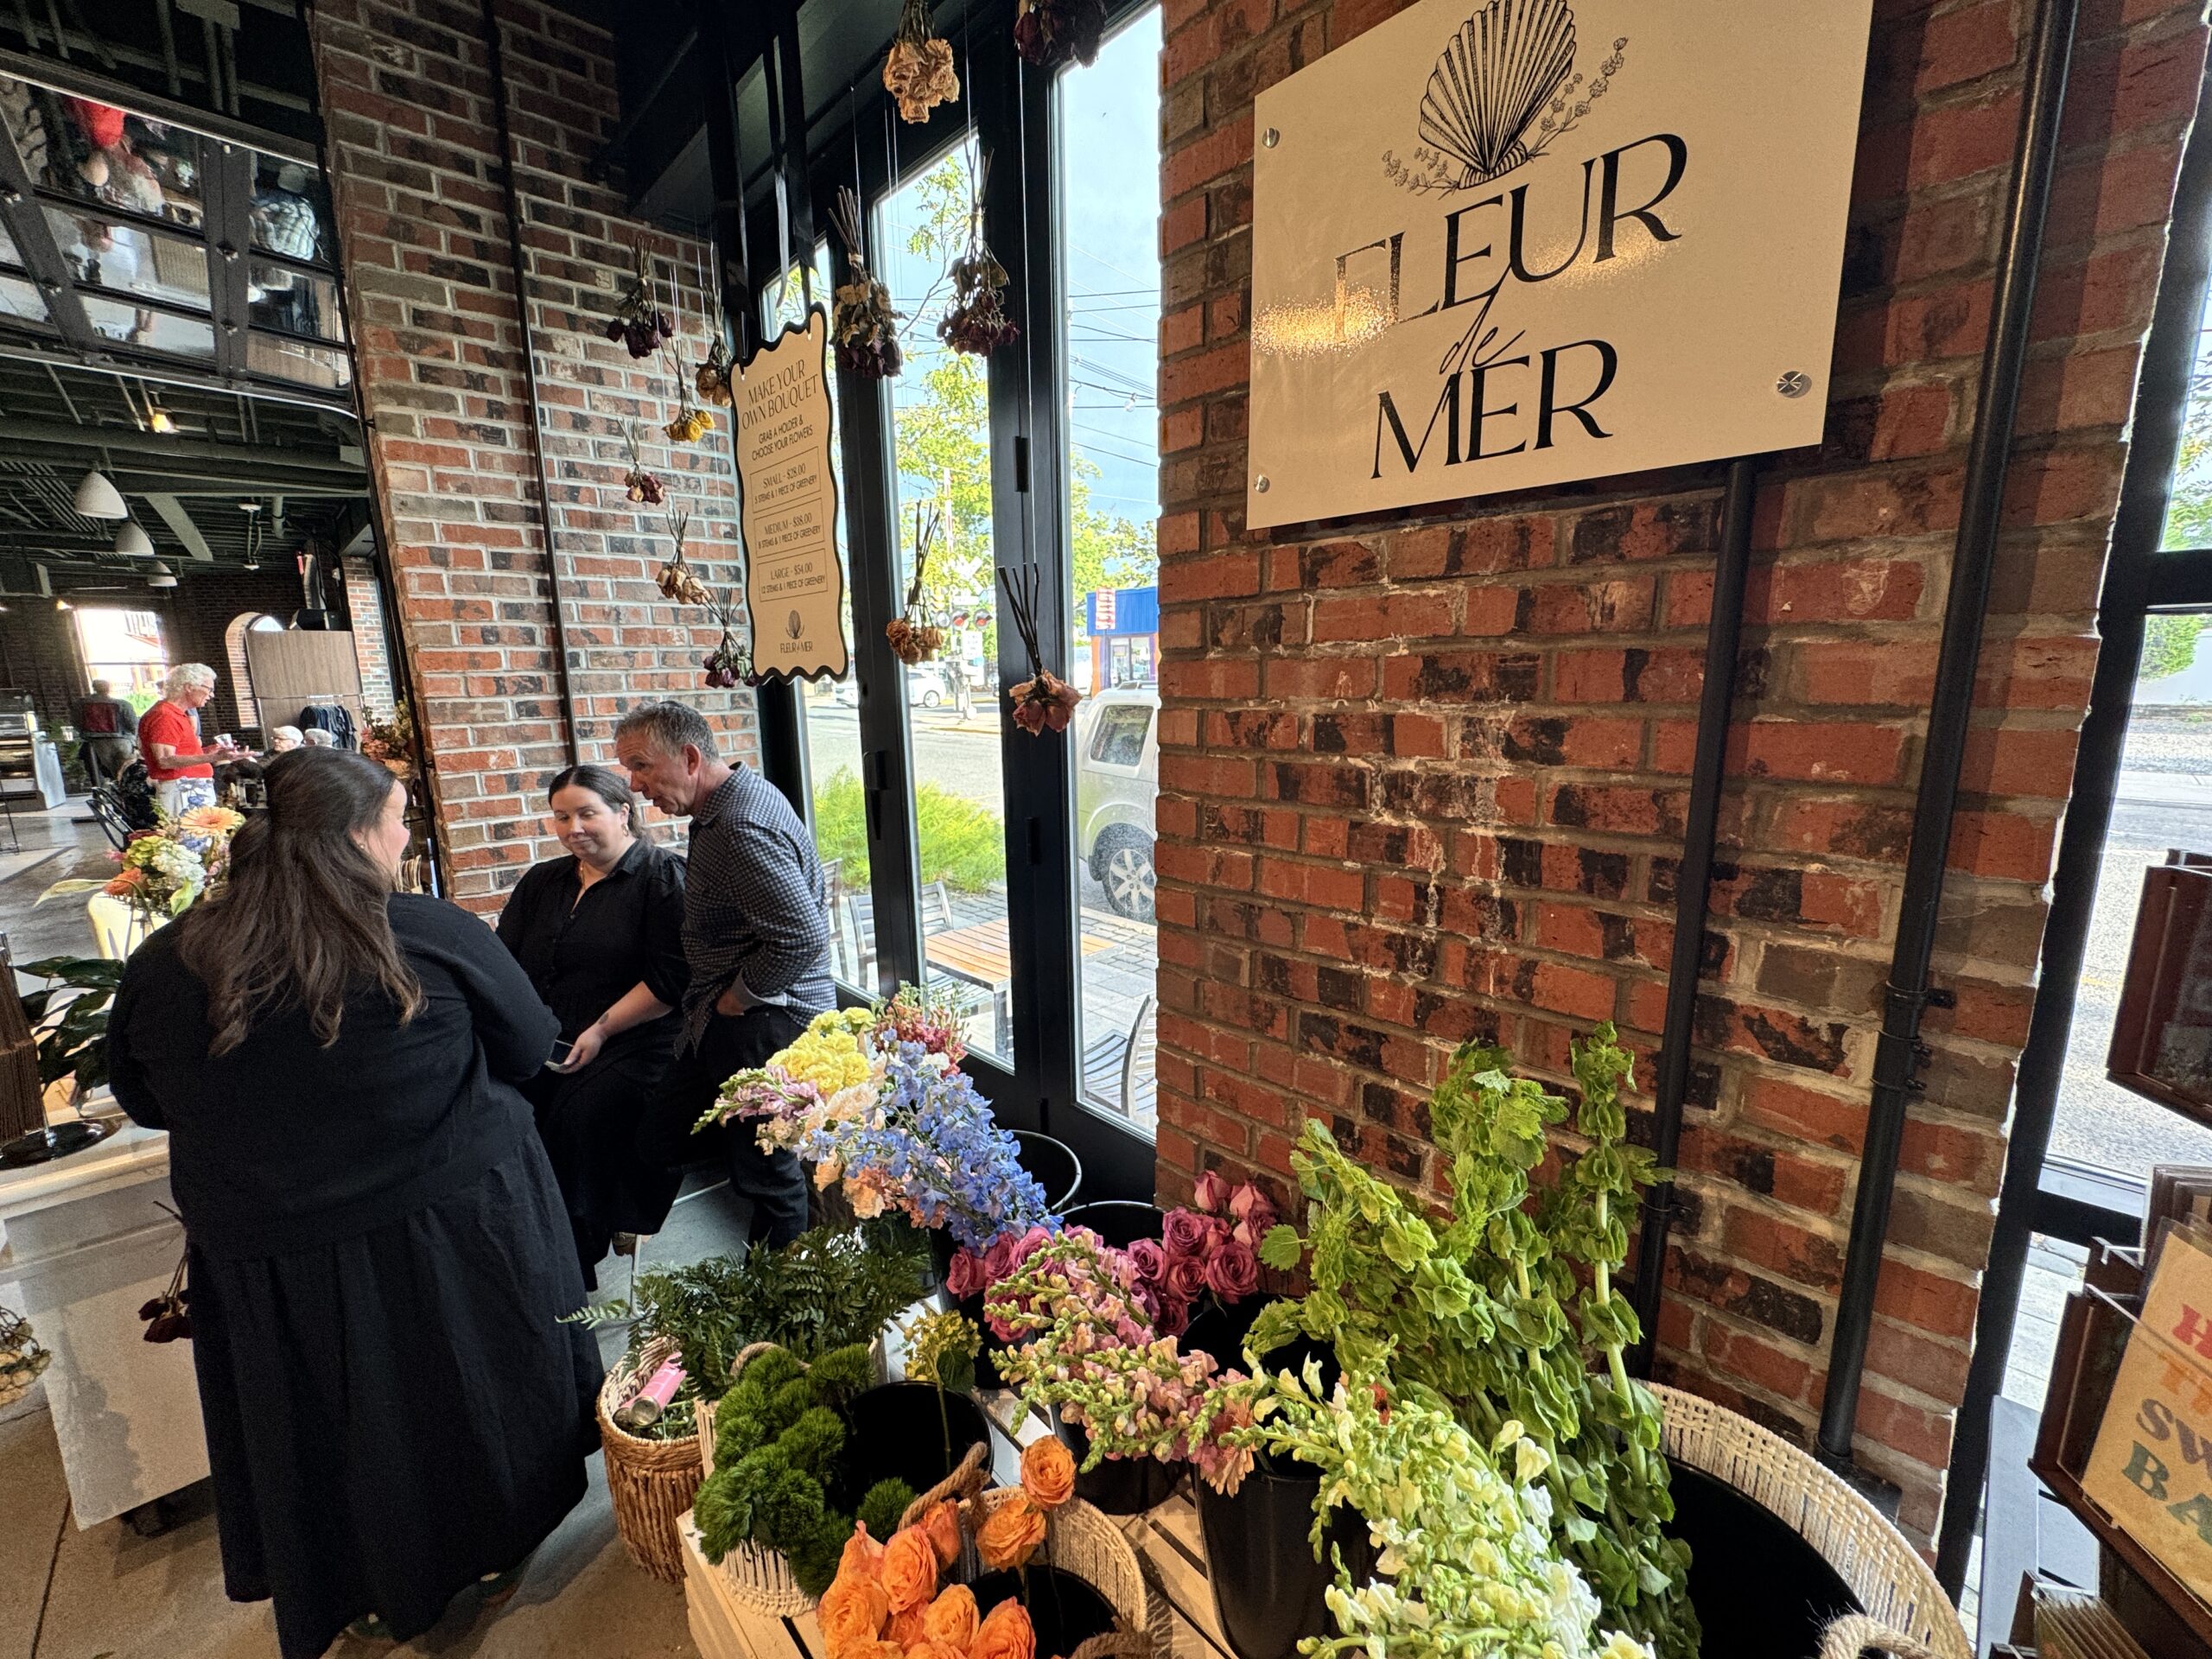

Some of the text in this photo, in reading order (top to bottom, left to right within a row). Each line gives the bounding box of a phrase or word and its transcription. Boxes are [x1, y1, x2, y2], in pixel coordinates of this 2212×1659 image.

[1334, 131, 1688, 342] FLEUR
[1438, 263, 1527, 413] de
[748, 359, 805, 406] MAKE YOUR
[741, 373, 818, 430] OWN BOUQUET
[1370, 339, 1618, 480] MER
[752, 423, 813, 461] CHOOSE YOUR FLOWERS
[759, 414, 804, 444] GRAB A HOLDER &
[758, 491, 771, 503] STEMS
[778, 484, 789, 495] PIECE
[789, 482, 796, 493] OF
[796, 474, 817, 490] GREENERY
[762, 473, 783, 489] SMALL
[761, 537, 774, 548] STEMS
[781, 532, 793, 543] PIECE
[793, 531, 799, 540] OF
[799, 524, 822, 538] GREENERY
[764, 519, 789, 535] MEDIUM
[766, 583, 779, 594] STEMS
[786, 580, 798, 589] PIECE
[798, 578, 804, 588] OF
[804, 574, 826, 587] GREENERY
[771, 567, 790, 581] LARGE
[794, 562, 813, 575] $54.00
[779, 642, 797, 654] FLEUR
